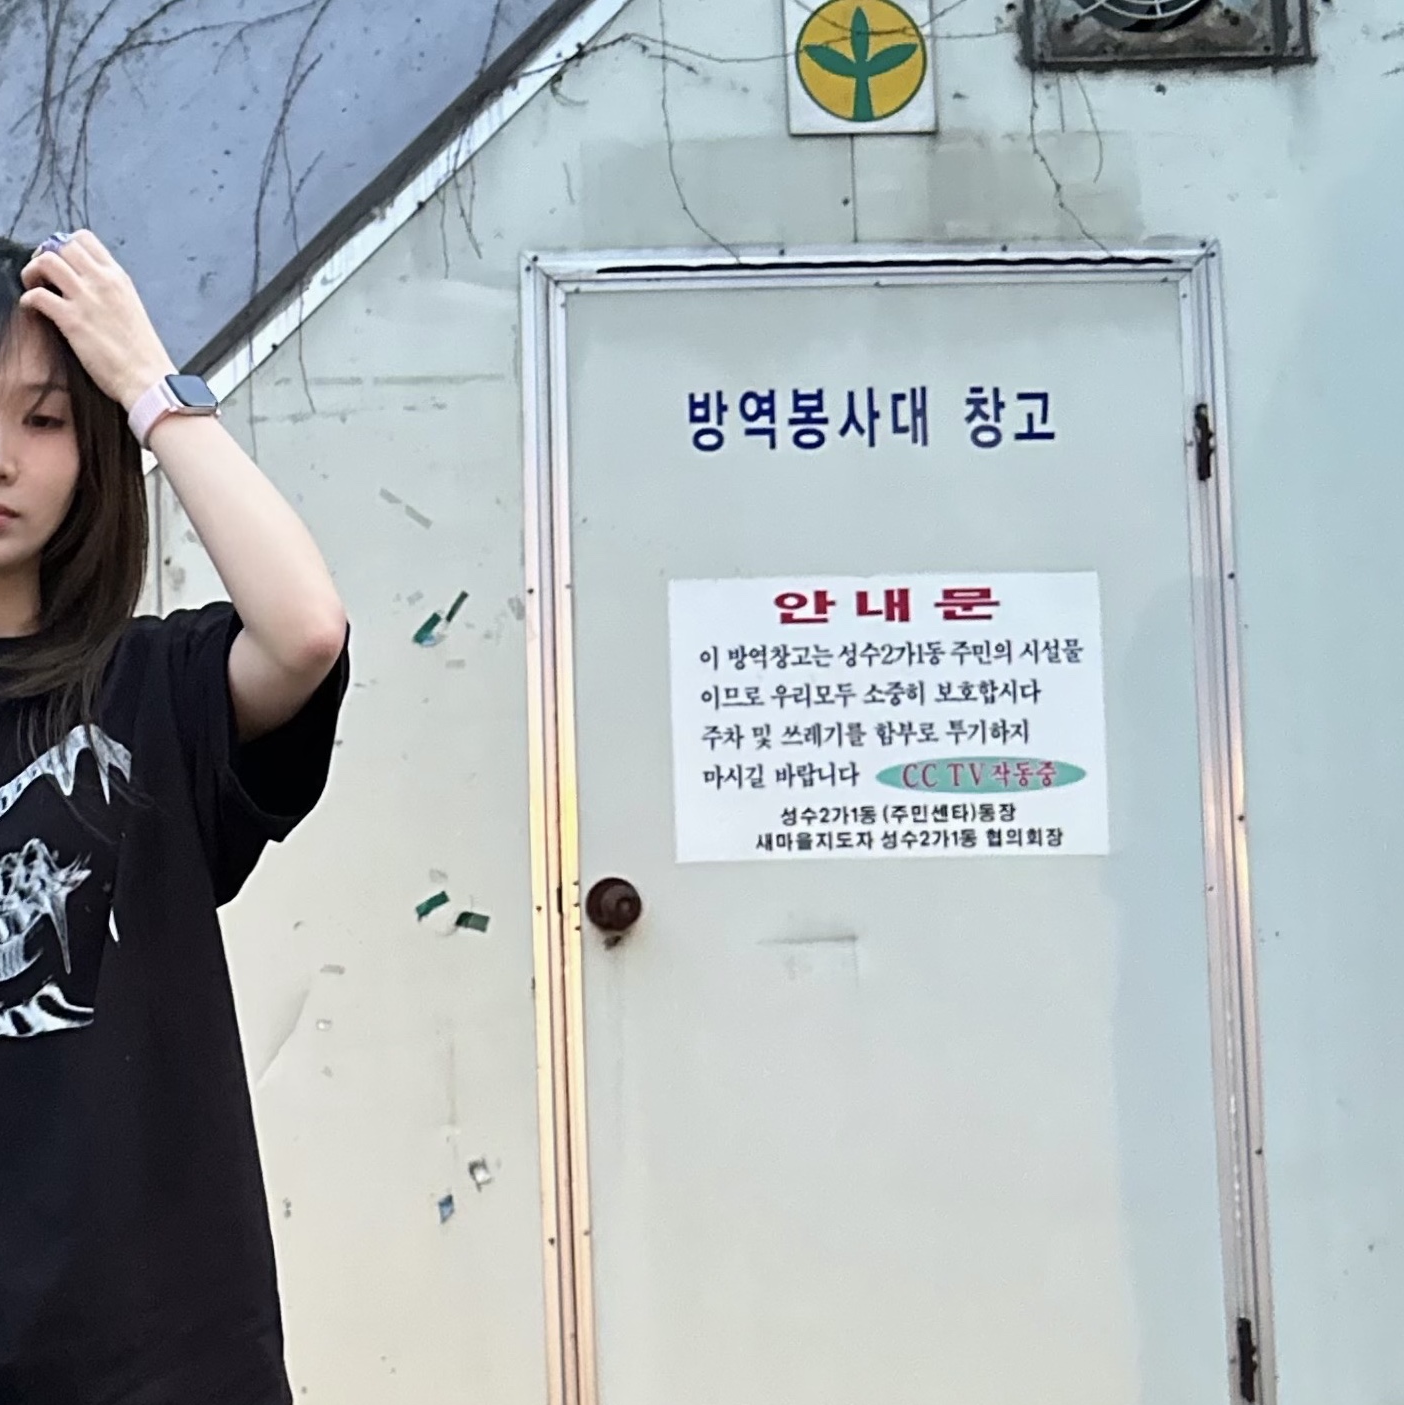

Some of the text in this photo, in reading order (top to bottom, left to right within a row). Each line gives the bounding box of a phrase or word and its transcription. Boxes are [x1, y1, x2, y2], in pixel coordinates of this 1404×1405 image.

[687, 383, 1056, 452] 방역봉사대 창고
[699, 637, 1084, 671] 이 방역창고는 성수2가1동 주민의 시설물
[700, 677, 1042, 711] 이므로 우리모두 소중히 보호합시다
[701, 717, 1031, 750] 주차 및 쓰레기를 함부로 투기하지
[703, 763, 766, 790] 마시길
[775, 761, 861, 789] 바랍니다
[781, 805, 877, 826] 성수2가1동
[755, 827, 1064, 852] 새마을지도자 성수2가1동 협의회장
